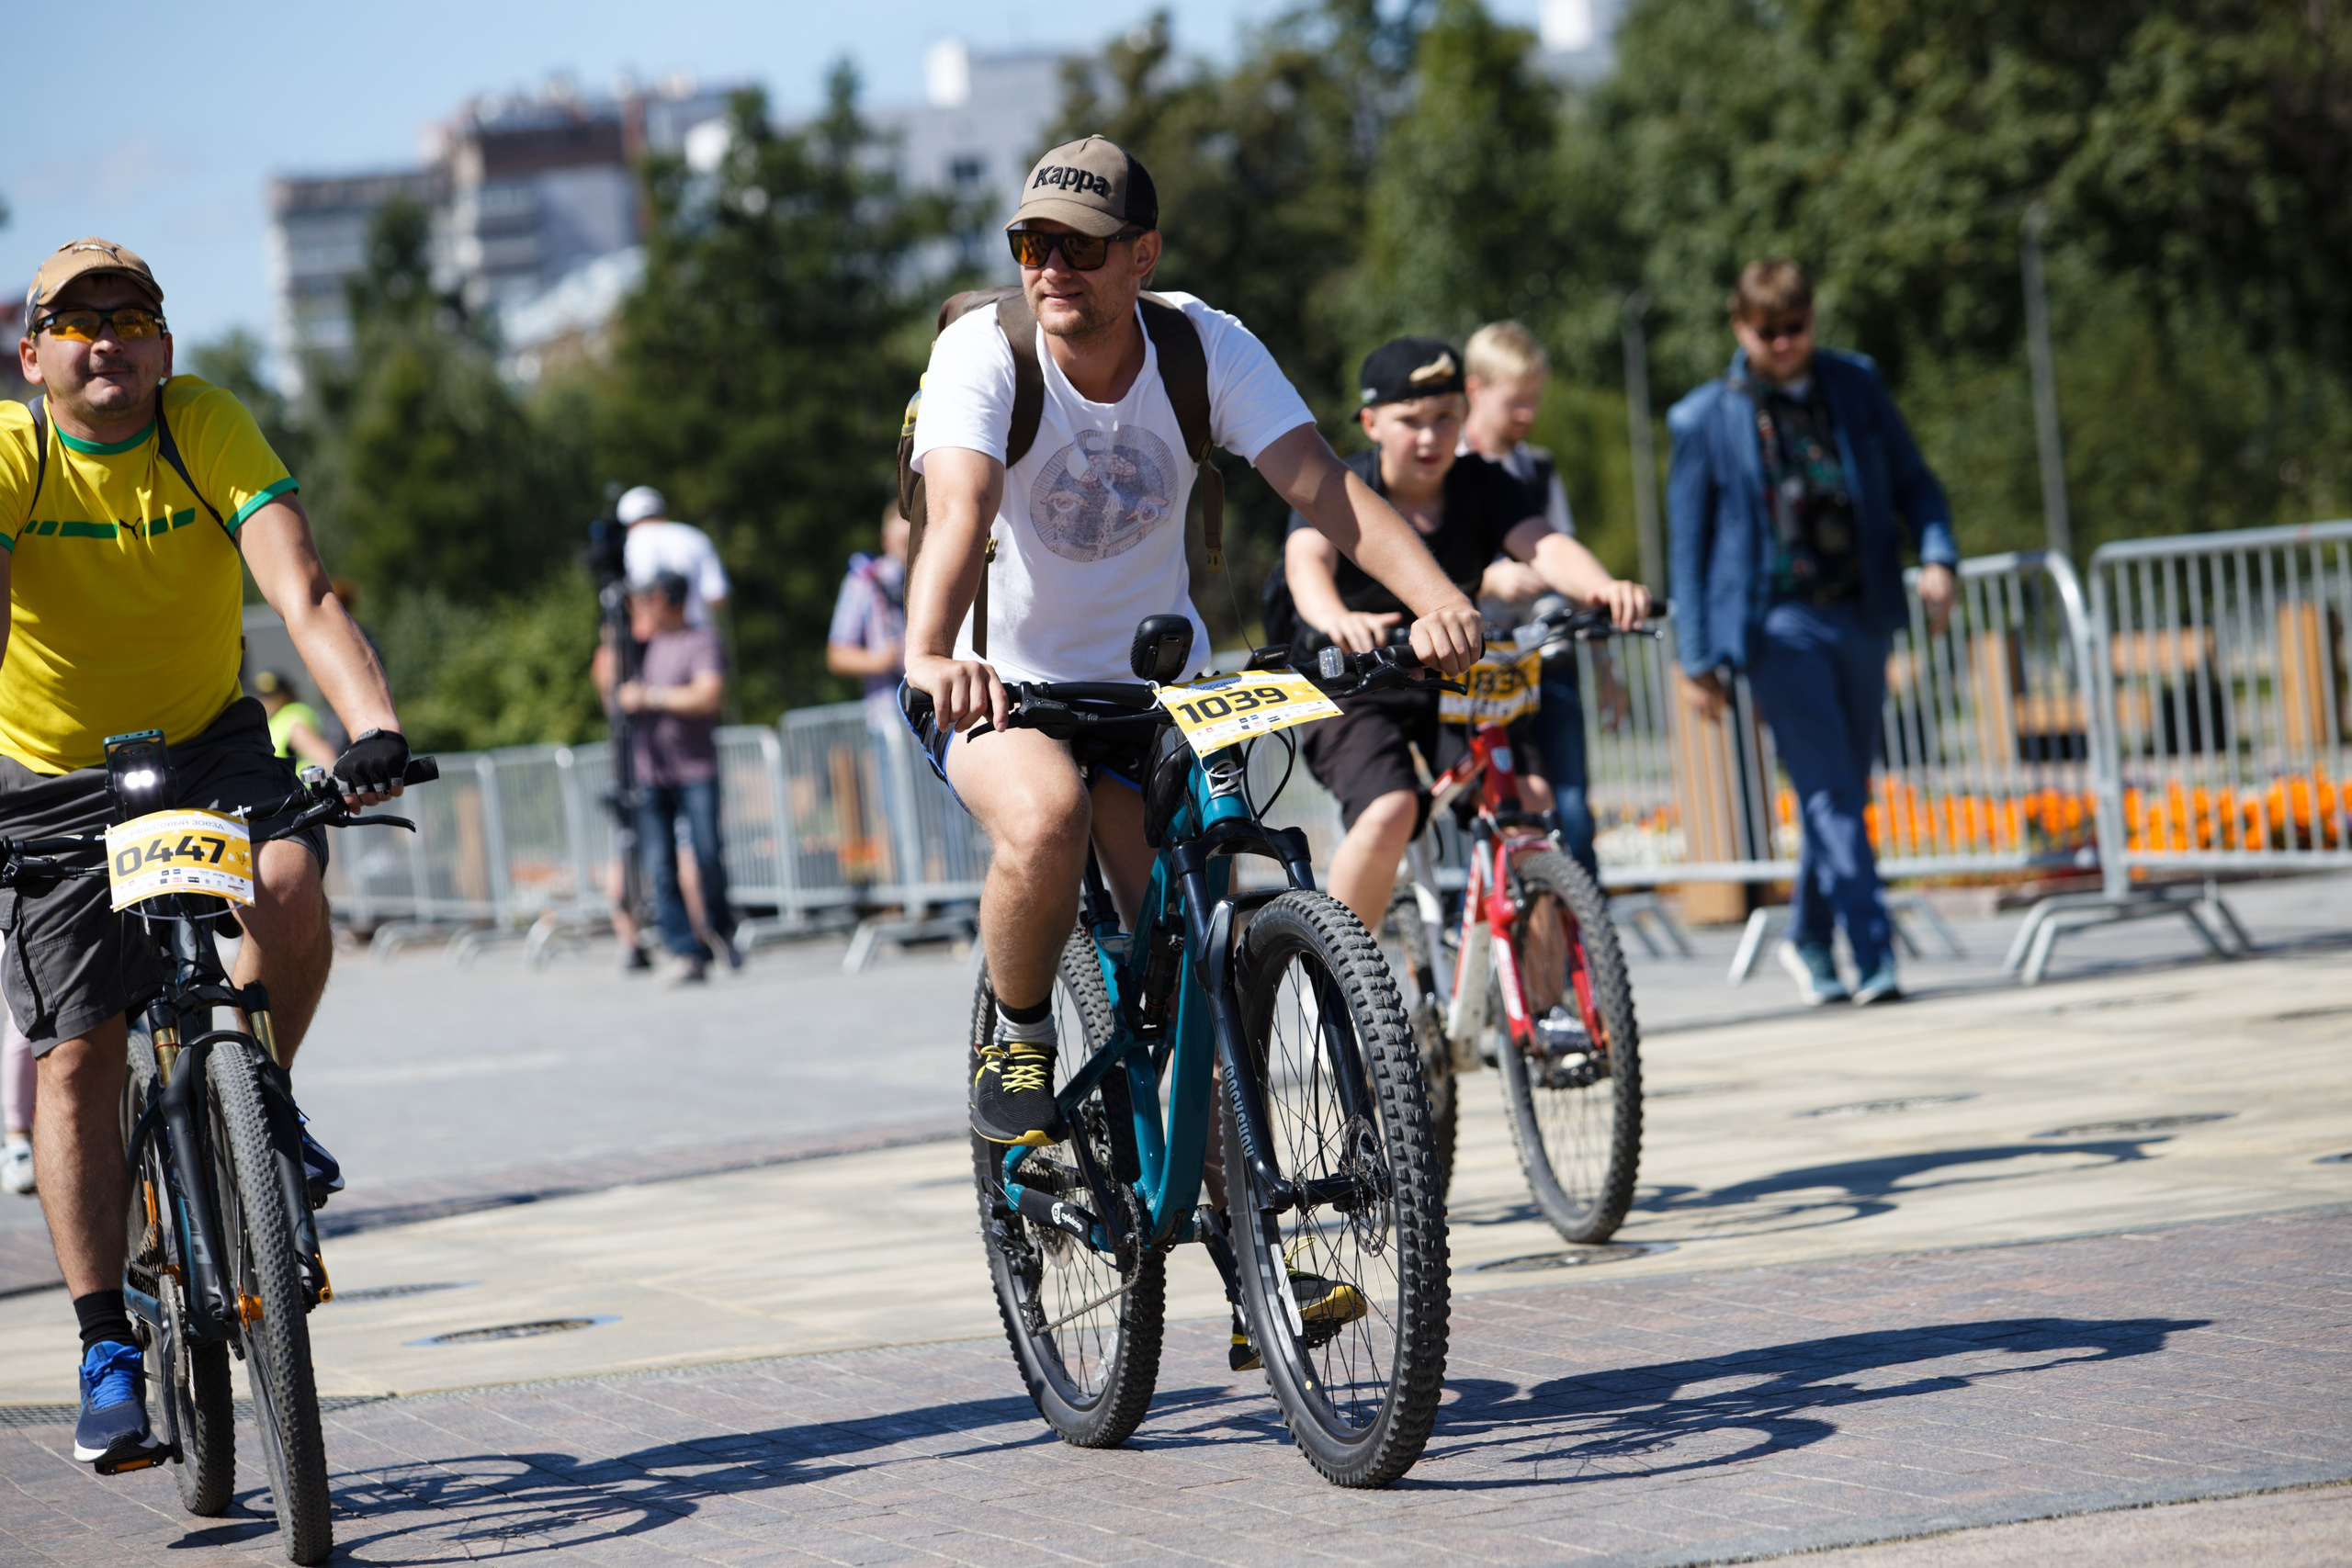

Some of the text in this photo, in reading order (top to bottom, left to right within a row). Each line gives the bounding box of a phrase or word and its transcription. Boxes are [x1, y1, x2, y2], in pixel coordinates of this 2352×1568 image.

[1032, 165, 1109, 197] Kappa
[1176, 687, 1288, 724] 1039
[116, 836, 225, 877] 0447
